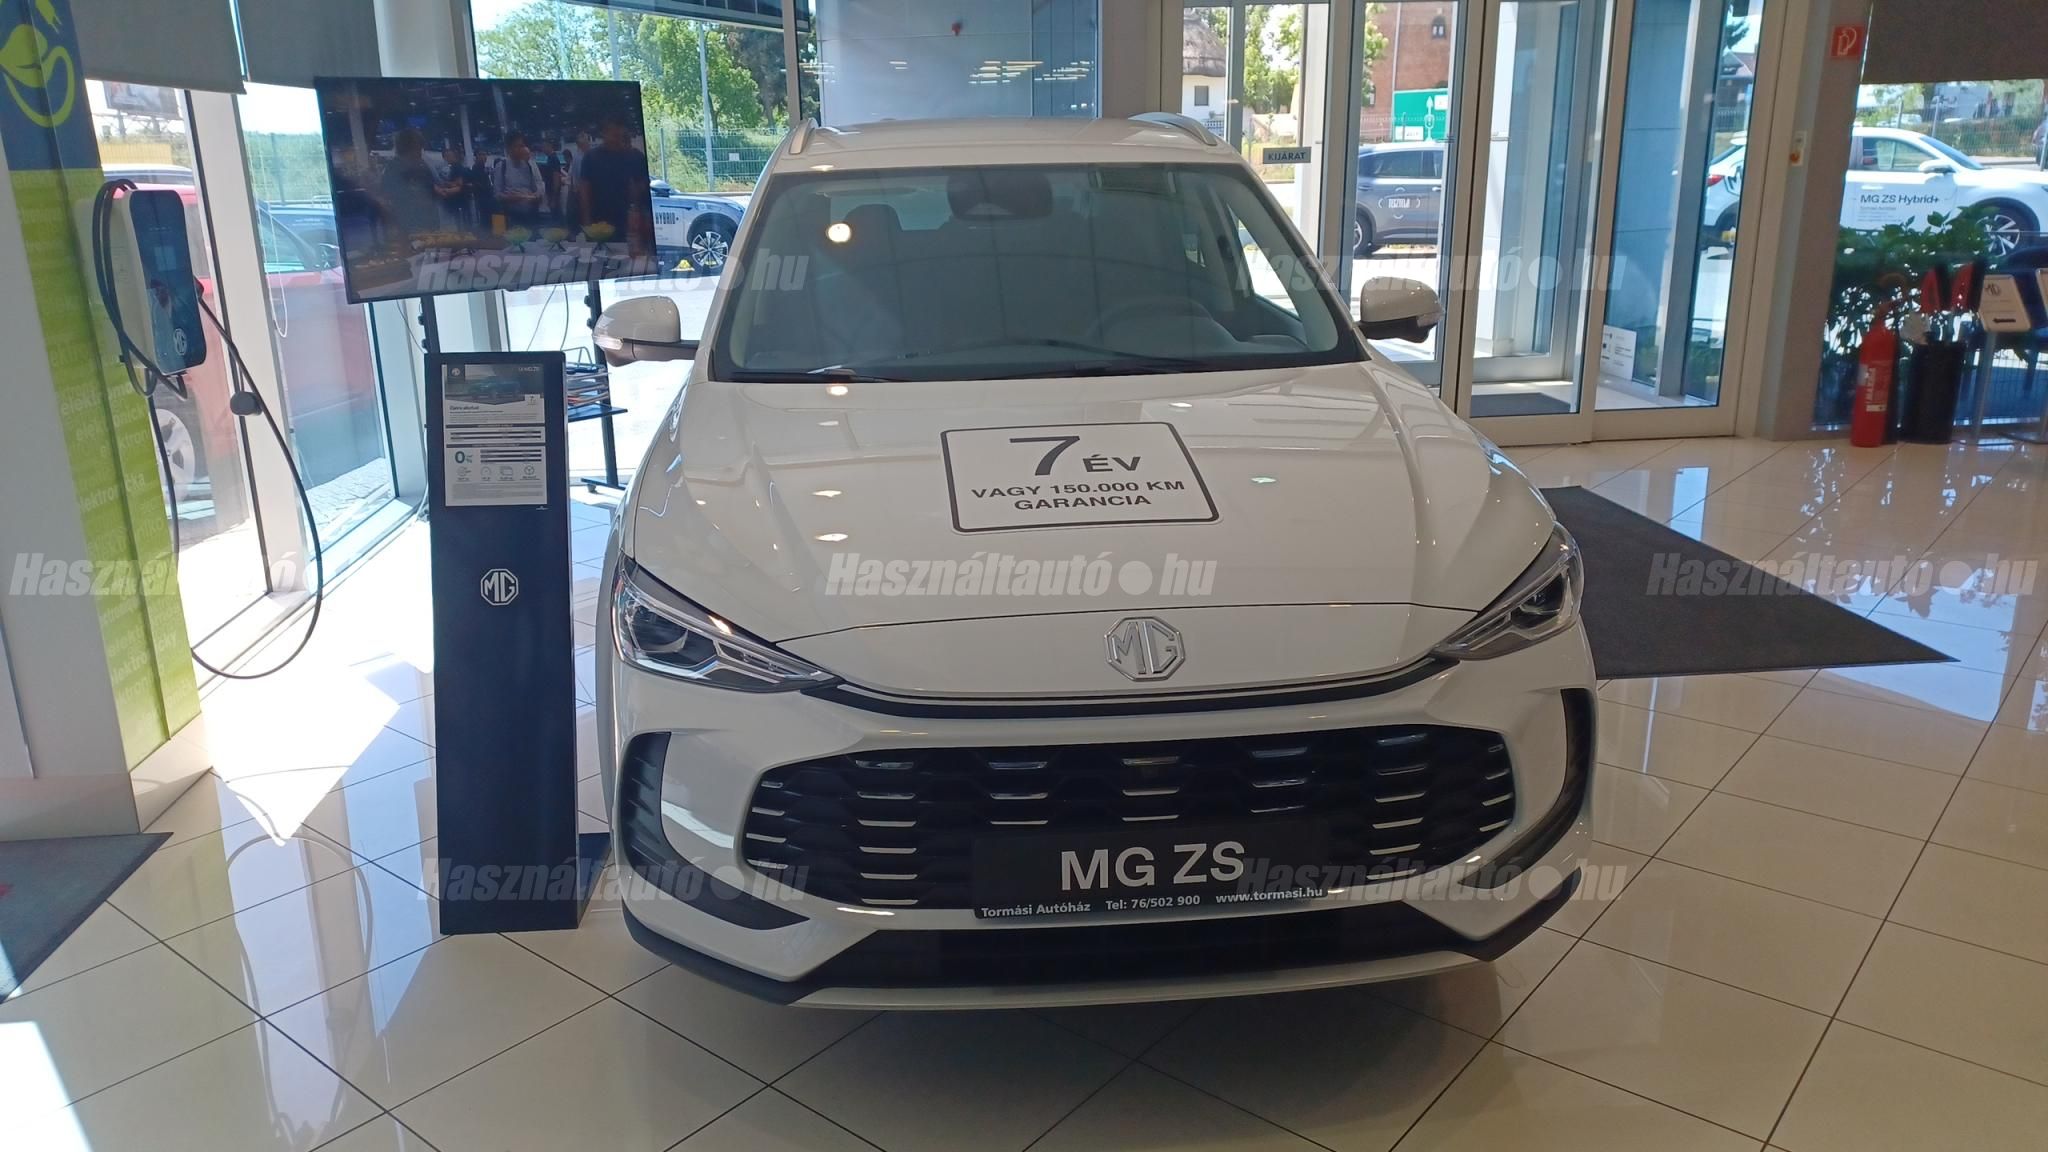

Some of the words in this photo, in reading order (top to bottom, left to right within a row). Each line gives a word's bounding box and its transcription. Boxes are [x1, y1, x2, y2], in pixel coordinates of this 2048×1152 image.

[1860, 194, 1880, 204] MG
[1881, 194, 1897, 204] ZS
[1898, 194, 1940, 206] Hybrid+
[1009, 436, 1081, 476] 7
[1083, 454, 1141, 473] ÉV
[971, 485, 1041, 499] VAGY
[1049, 481, 1139, 494] 150.000
[1146, 480, 1186, 491] KM
[1014, 495, 1152, 511] GARANCIA
[483, 571, 516, 602] MG
[1109, 618, 1181, 677] MG
[1061, 846, 1155, 892] MG
[1173, 840, 1246, 885] ZS
[981, 904, 1034, 918] Tormási
[1036, 901, 1091, 915] Autóház
[1105, 899, 1128, 911] Tel:
[1131, 896, 1174, 909] 76/502
[1177, 895, 1201, 907] 900
[1215, 887, 1324, 904] www.tormasi.hu
